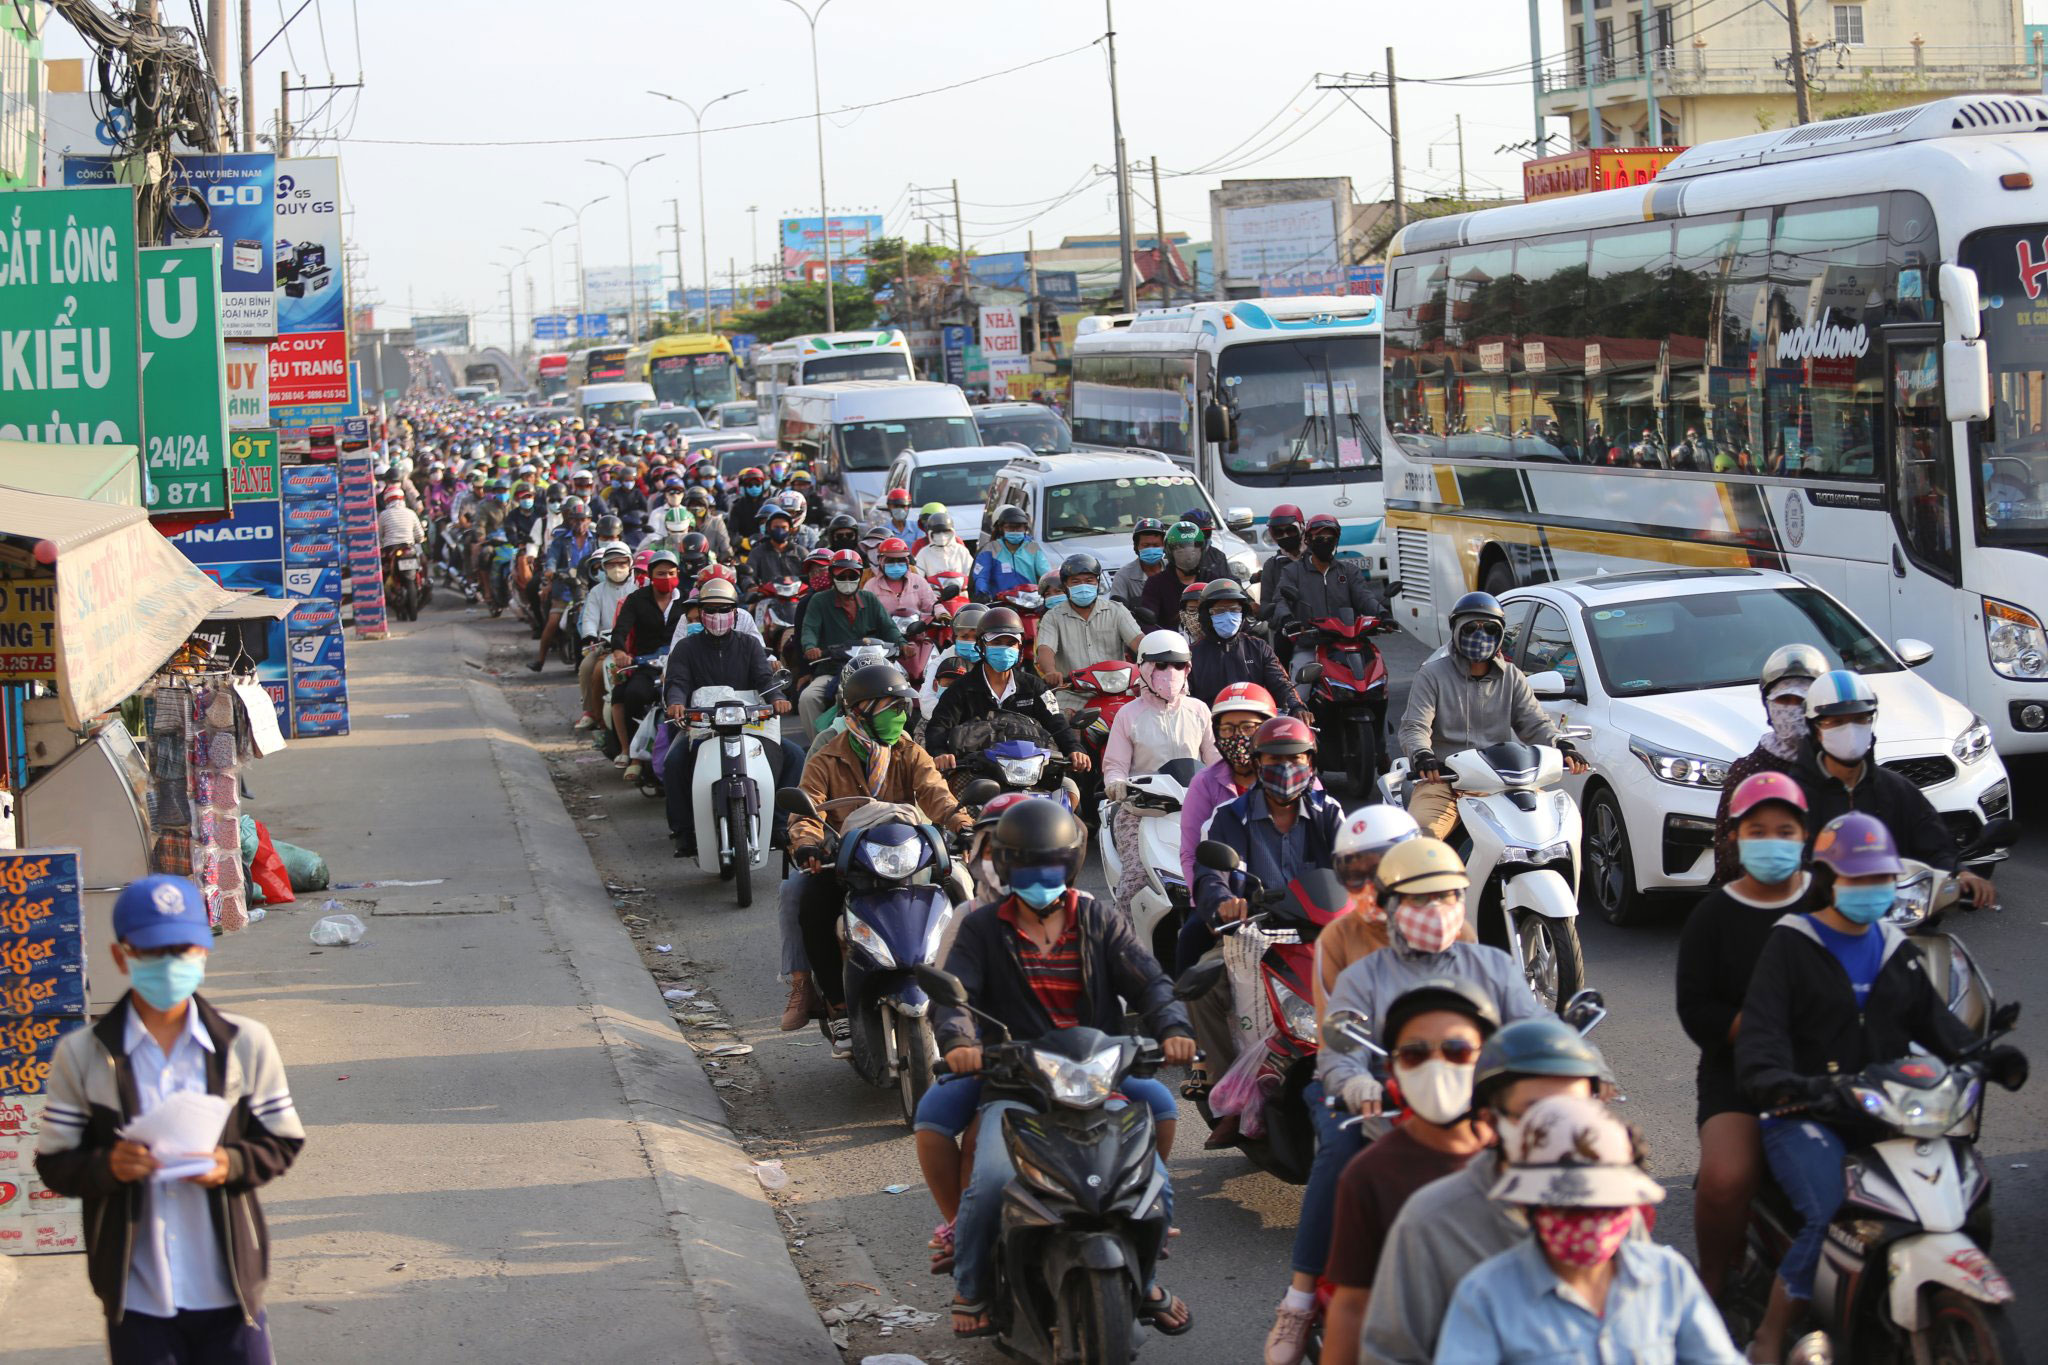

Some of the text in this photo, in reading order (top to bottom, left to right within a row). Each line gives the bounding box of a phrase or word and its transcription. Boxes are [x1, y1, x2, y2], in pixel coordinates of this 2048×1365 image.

[77, 168, 104, 179] CÔNG
[241, 169, 262, 178] NAM
[295, 189, 311, 198] GS
[277, 202, 334, 215] QUY GS
[50, 214, 118, 284] LÔNG
[985, 308, 1015, 328] NHÀ
[1777, 306, 1869, 361] mobihome
[2, 295, 111, 391] KIỂU
[293, 338, 327, 351] QUY
[292, 359, 344, 377] TRANG
[347, 421, 365, 431] GS
[150, 435, 209, 470] 24/24
[168, 482, 210, 504] 871
[172, 526, 273, 543] PINACO
[289, 574, 311, 585] GS
[293, 642, 314, 652] GS
